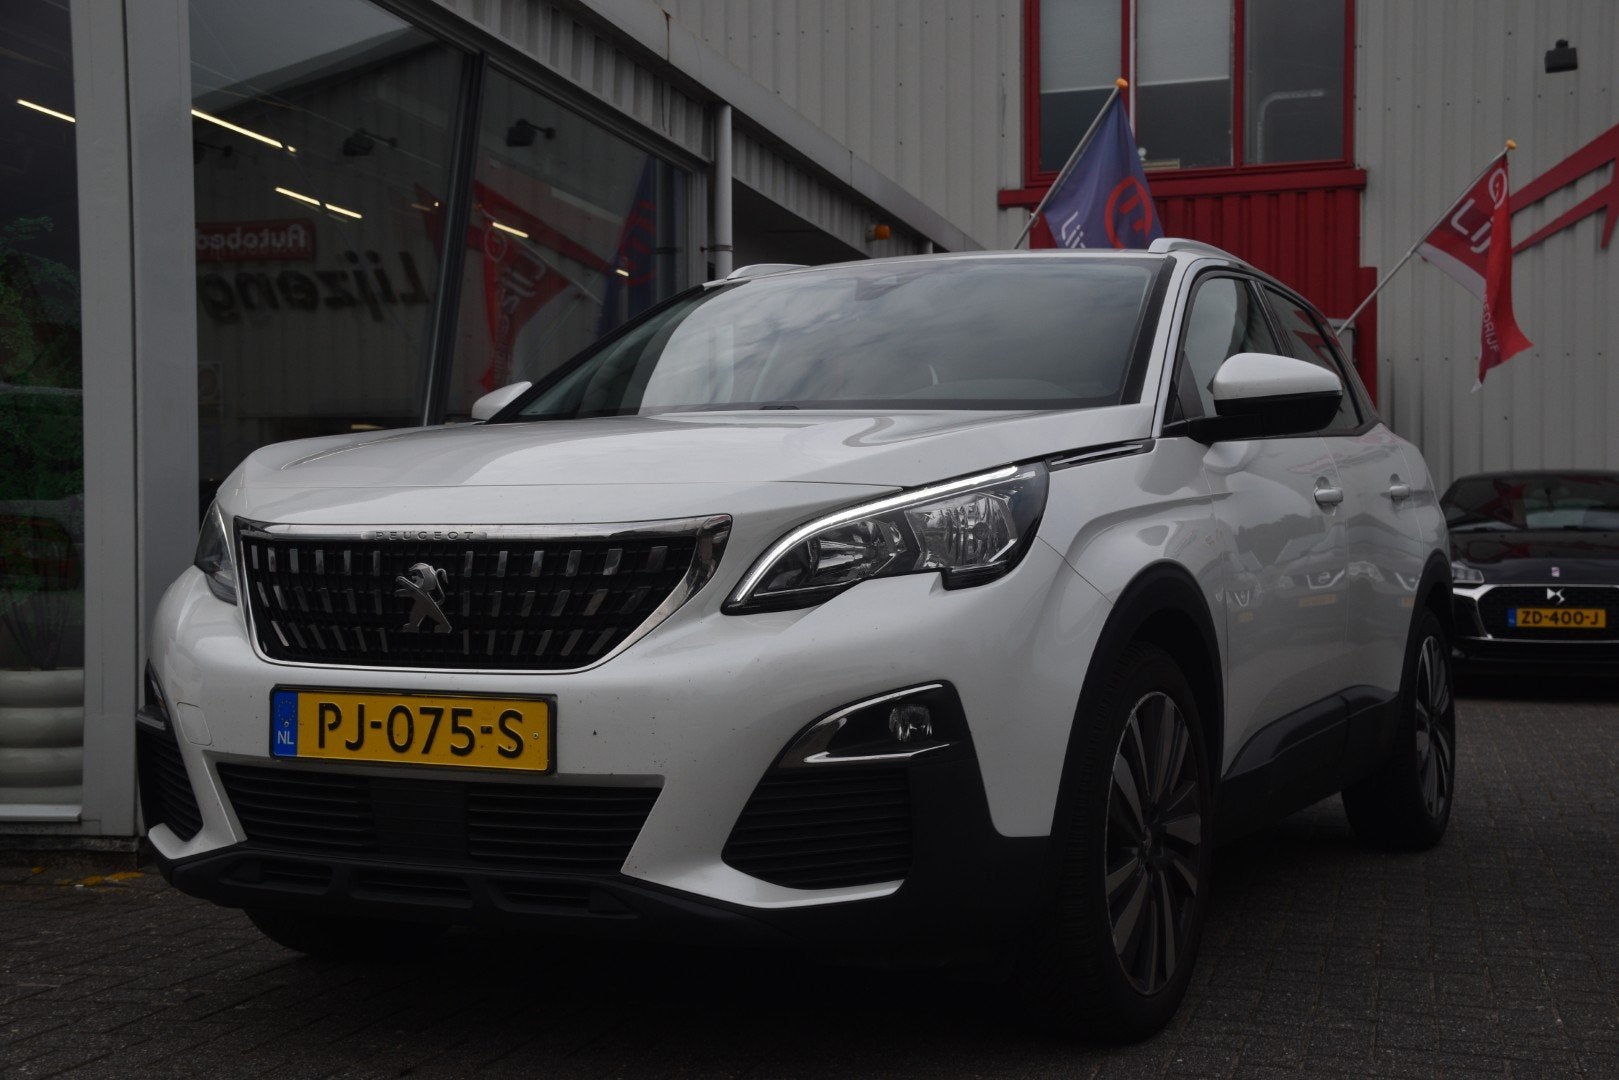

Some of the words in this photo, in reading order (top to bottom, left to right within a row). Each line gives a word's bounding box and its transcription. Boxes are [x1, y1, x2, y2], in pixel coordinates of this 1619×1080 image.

[375, 531, 474, 540] PEUGEOT
[1521, 610, 1599, 625] ZD-400-J
[277, 730, 294, 745] NL
[318, 702, 525, 758] PJ-075-S
